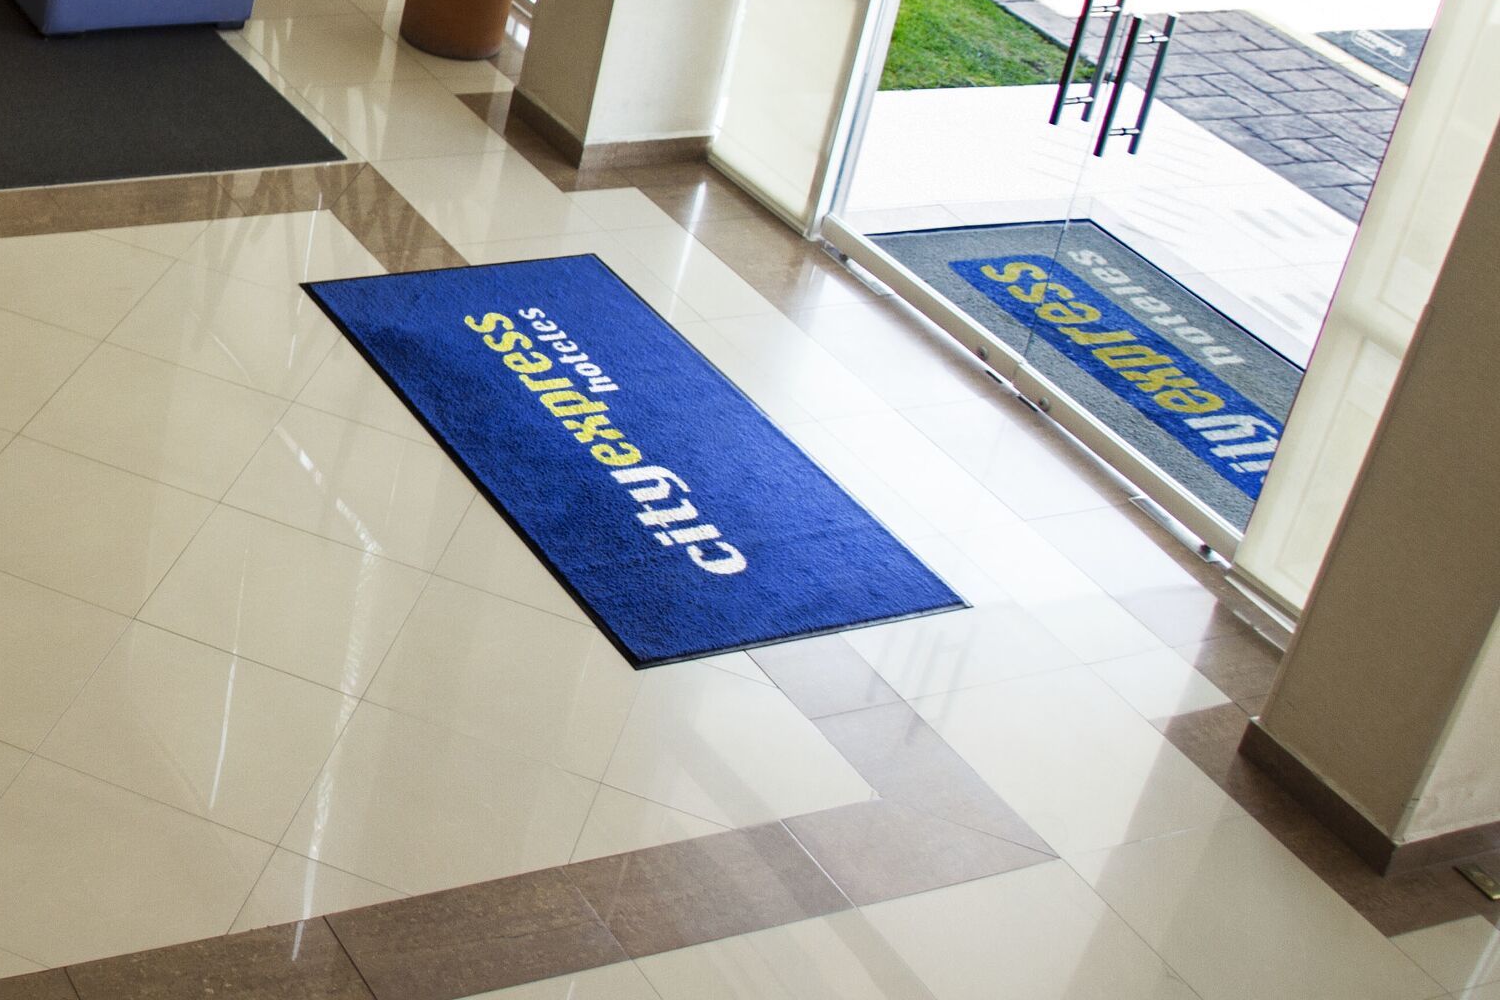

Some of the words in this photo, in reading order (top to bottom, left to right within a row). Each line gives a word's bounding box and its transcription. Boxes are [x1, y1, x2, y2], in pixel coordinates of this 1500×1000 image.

[518, 306, 620, 393] hoteles
[980, 261, 1279, 480] ityexpress
[1067, 249, 1245, 366] hoteles
[463, 312, 748, 575] cityexpress
